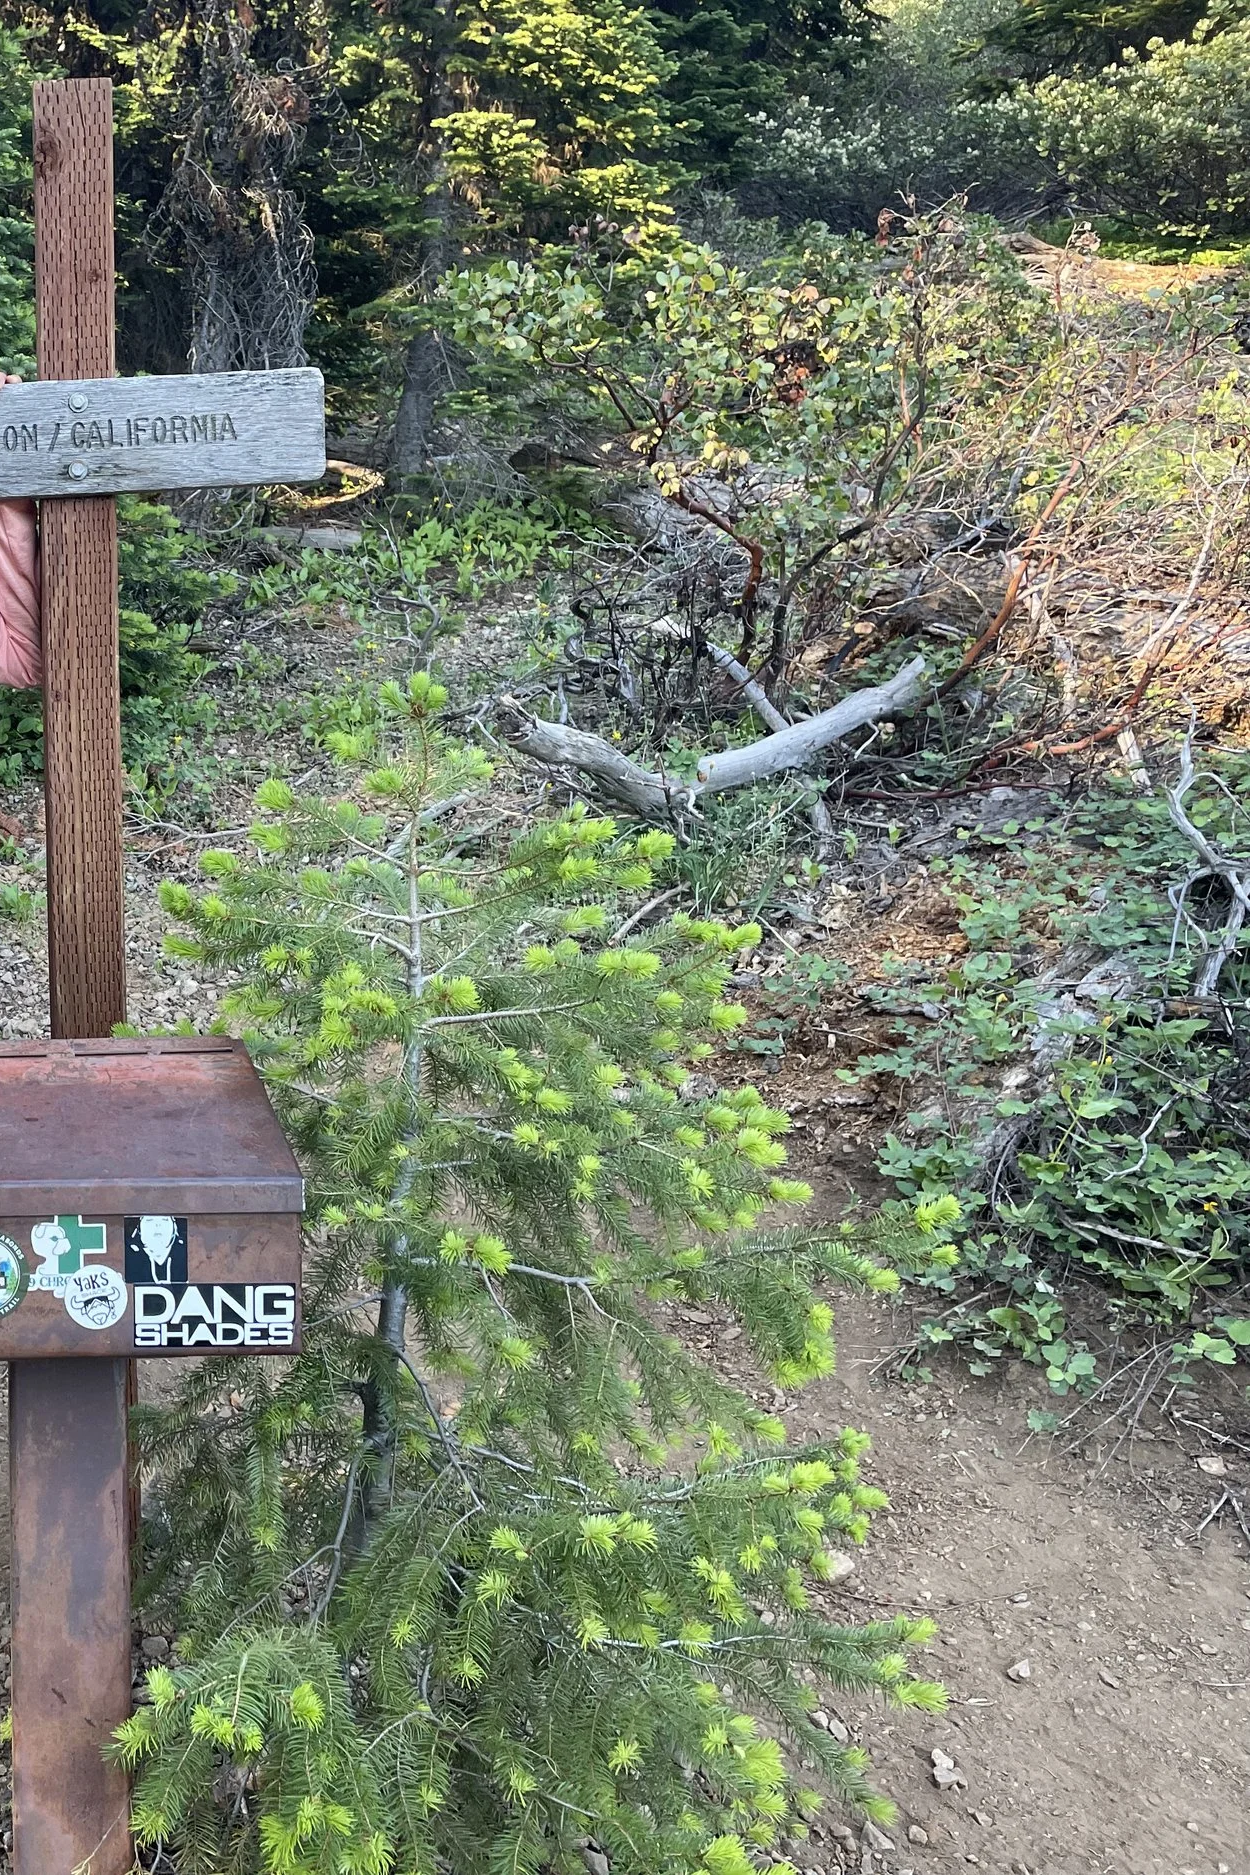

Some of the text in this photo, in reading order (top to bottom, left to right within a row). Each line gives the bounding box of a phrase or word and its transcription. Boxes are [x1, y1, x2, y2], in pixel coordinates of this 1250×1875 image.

[70, 412, 238, 450] CALIFORNIA
[0, 1297, 20, 1315] TRAIL
[134, 1284, 295, 1325] DANG
[135, 1322, 294, 1347] SHADES
